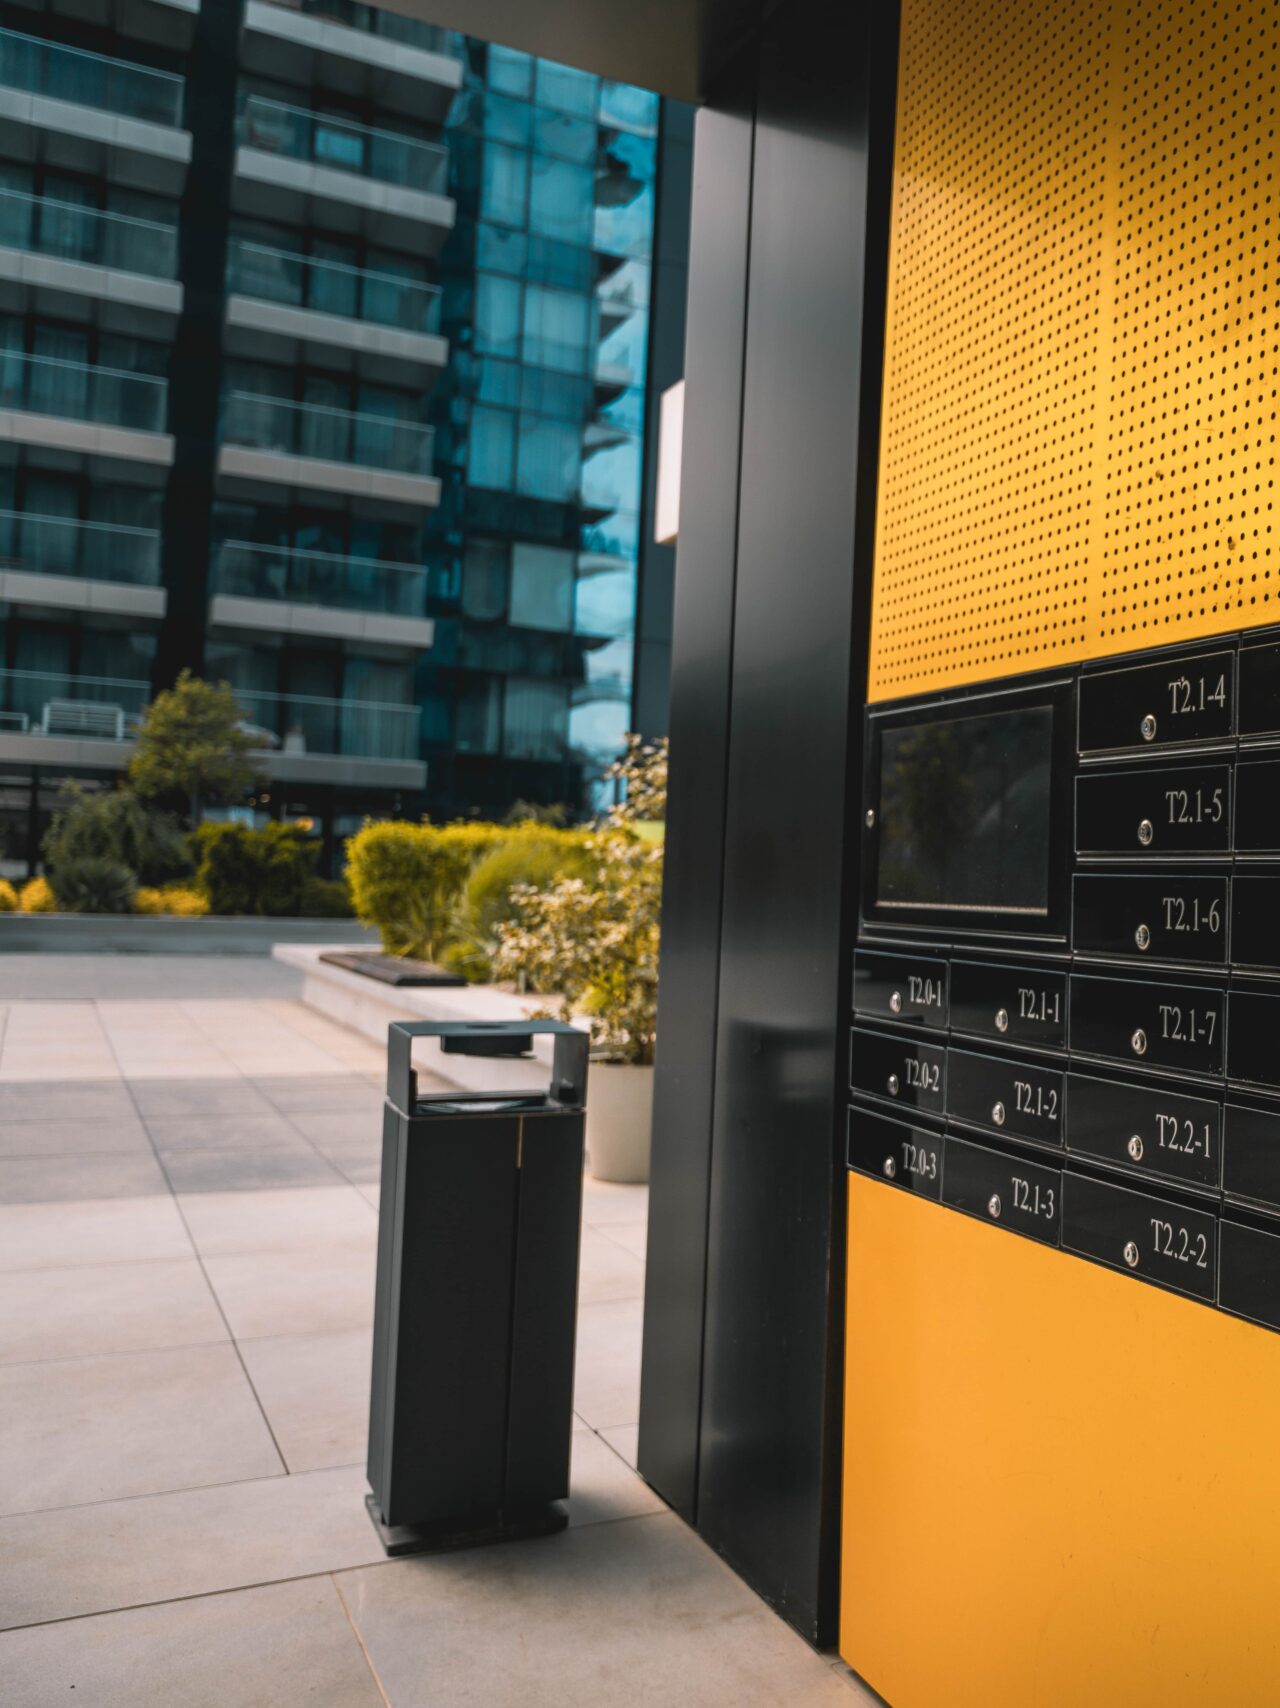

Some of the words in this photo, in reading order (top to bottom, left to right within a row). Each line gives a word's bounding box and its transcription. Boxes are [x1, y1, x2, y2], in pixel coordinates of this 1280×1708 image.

[1169, 674, 1225, 714] T2.1-4
[1166, 789, 1222, 823] T2.1-5
[1163, 898, 1220, 933] T2.1-6
[908, 976, 942, 1007] T2.0-1
[1019, 989, 1060, 1023] T2.1-1
[1159, 1005, 1217, 1045] T2.1-7
[905, 1058, 940, 1092] T2.0-2
[1014, 1081, 1057, 1120] T2.1-2
[1155, 1114, 1211, 1158] T2.2-1
[902, 1143, 937, 1180] T2.0-3
[1012, 1178, 1055, 1219] T2.1-3
[1151, 1219, 1207, 1268] T2.2-2
